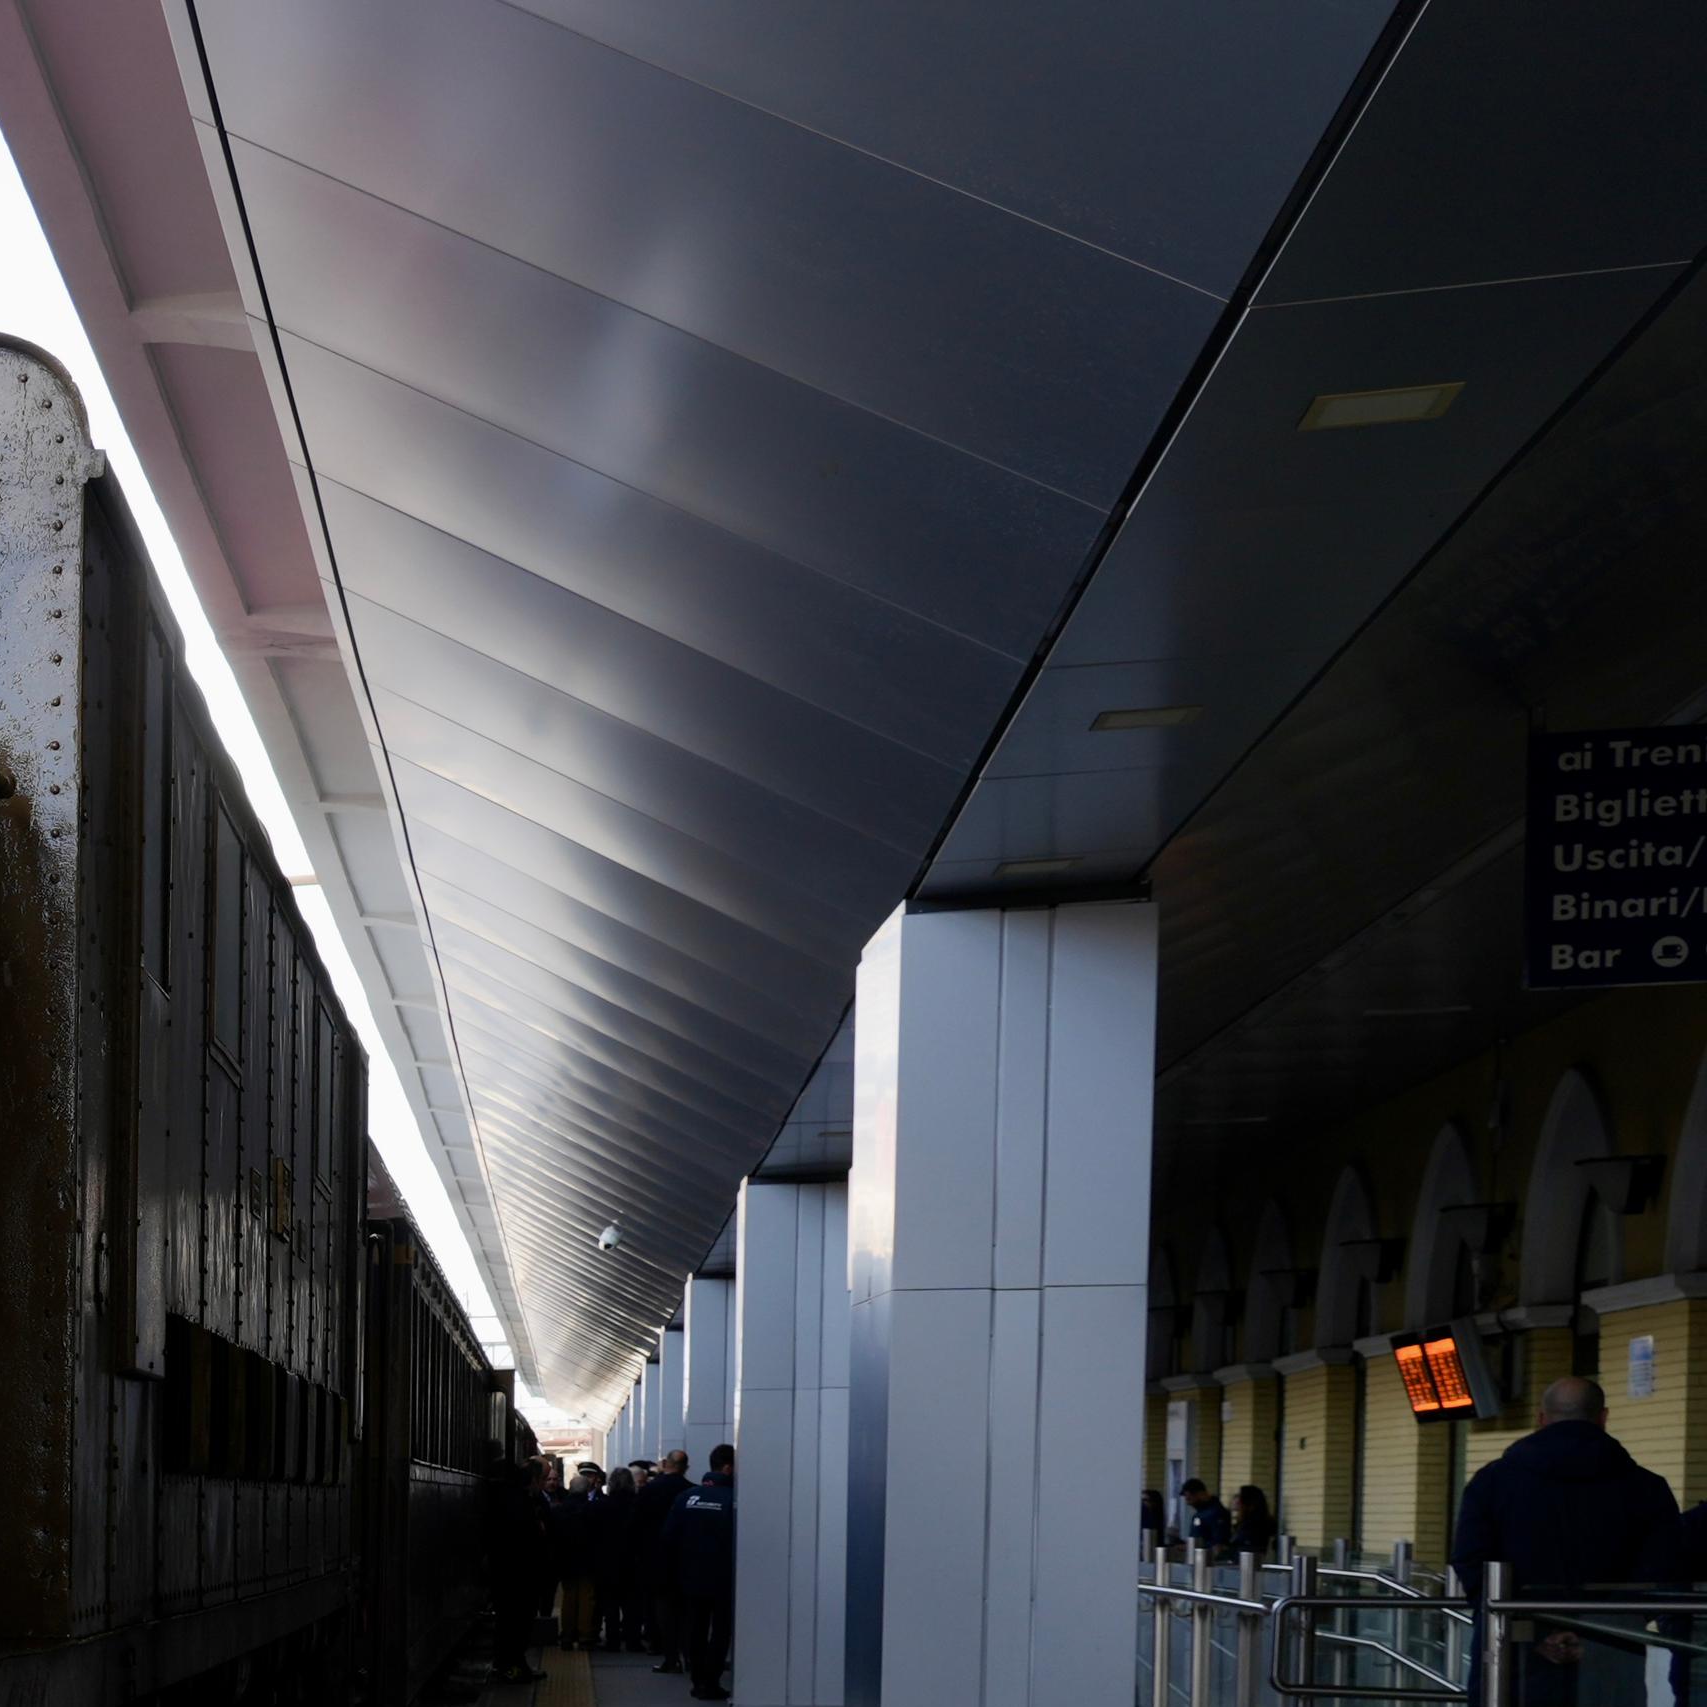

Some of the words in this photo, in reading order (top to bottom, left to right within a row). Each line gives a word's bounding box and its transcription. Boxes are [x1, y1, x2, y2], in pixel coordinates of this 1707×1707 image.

[1557, 741, 1593, 771] ai
[1608, 736, 1707, 768] Tren
[1551, 886, 1707, 922] Binari/
[1550, 943, 1623, 971] Bar
